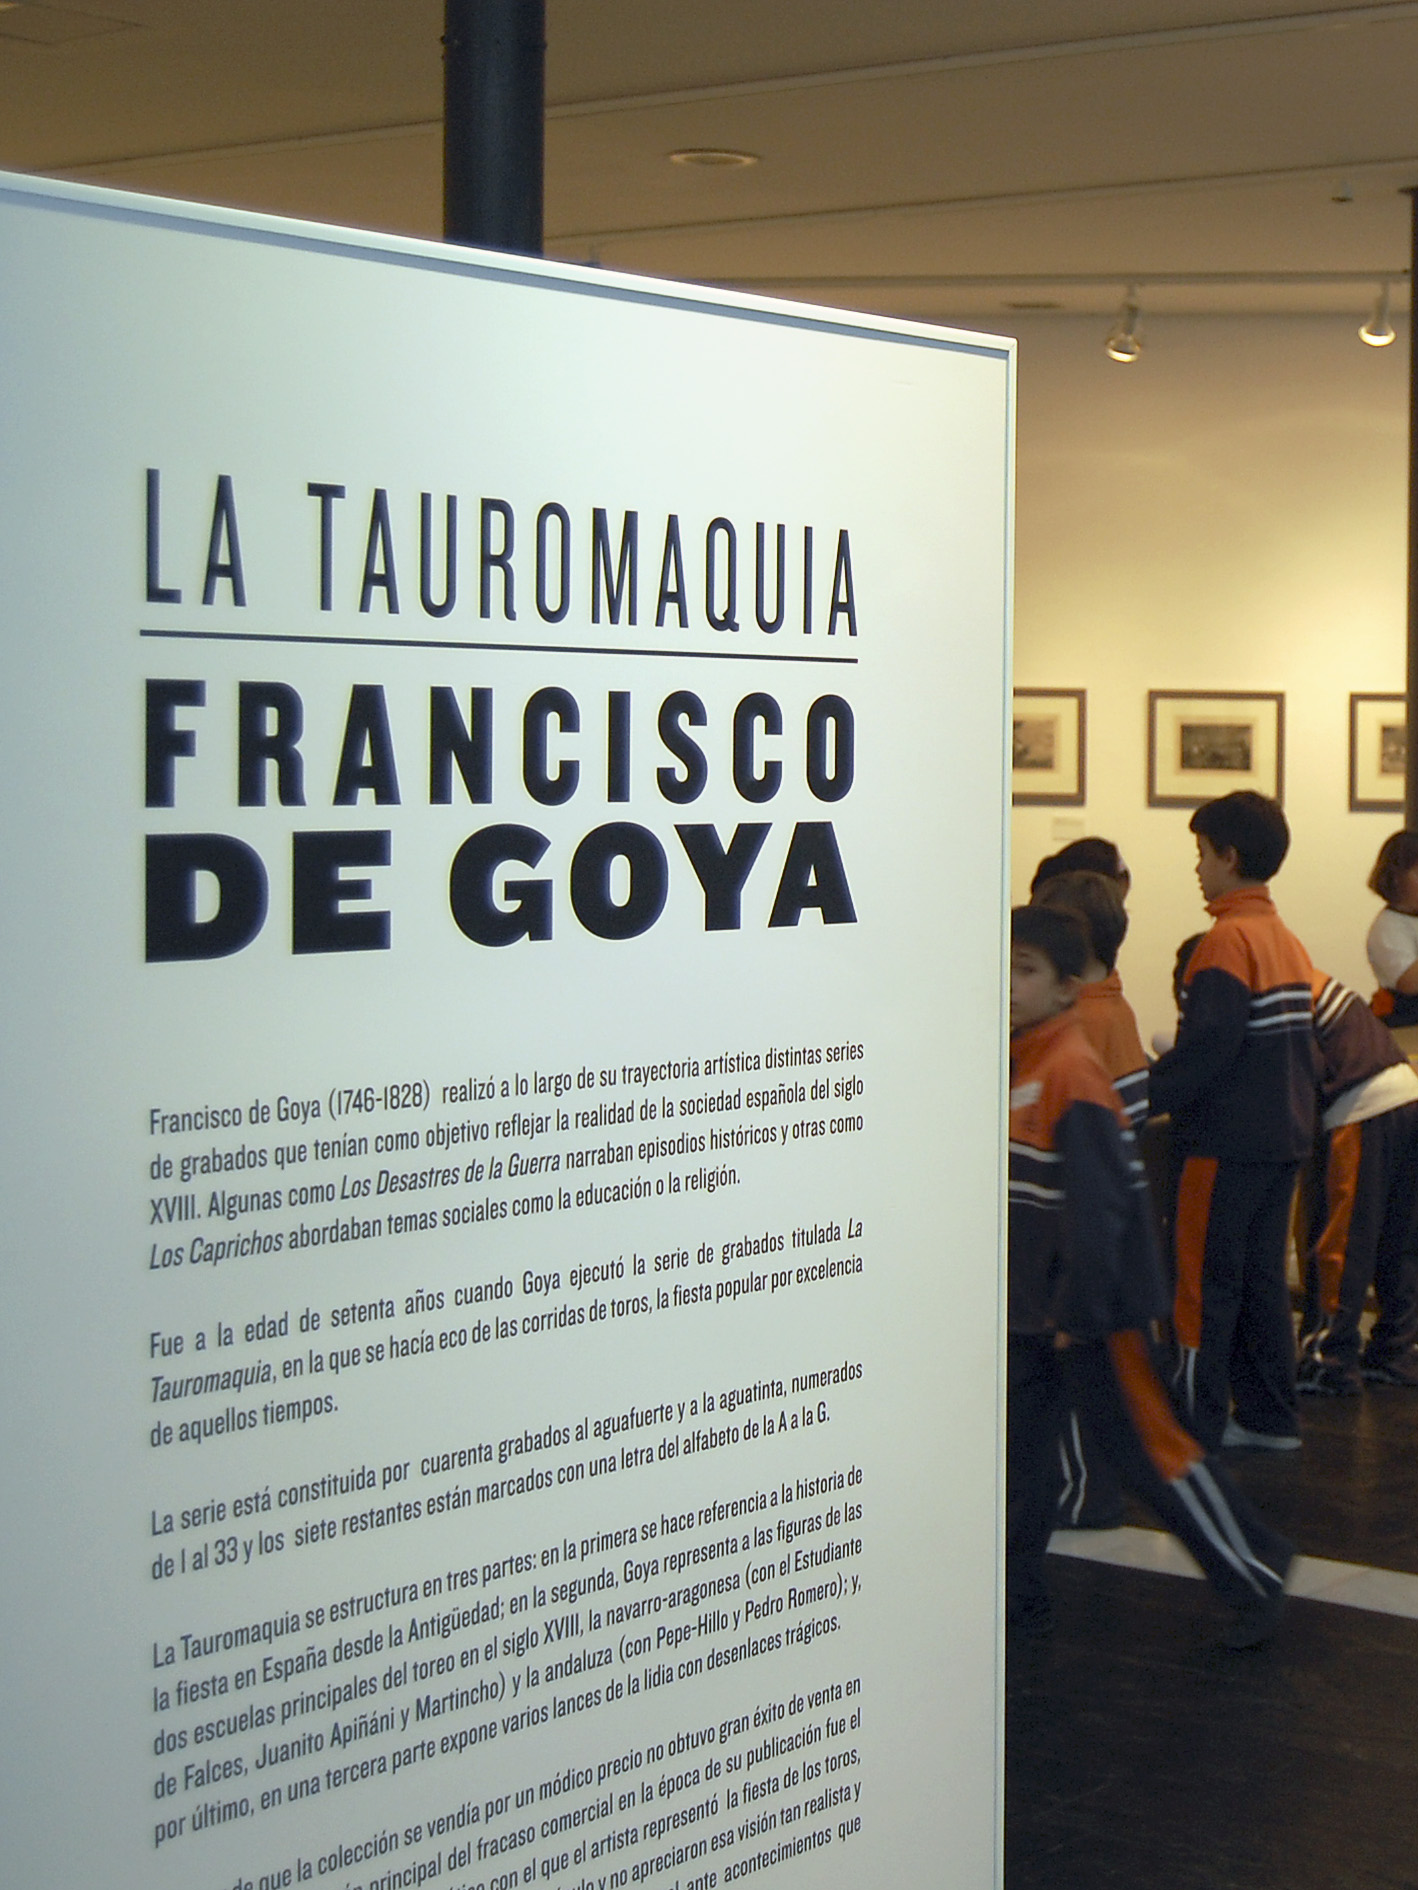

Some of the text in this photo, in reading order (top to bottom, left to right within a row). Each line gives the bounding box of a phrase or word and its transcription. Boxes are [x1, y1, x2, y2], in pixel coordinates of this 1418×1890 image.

[146, 468, 859, 636] LA TAUROMAQUIA
[145, 678, 856, 808] FRANCISCO
[145, 821, 859, 963] DE GOYA
[149, 1104, 243, 1136] Francisco
[248, 1098, 271, 1125] de
[276, 1095, 322, 1125] Goya
[441, 1074, 496, 1105] realizó
[499, 1079, 511, 1099] a
[514, 1072, 529, 1097] lo
[533, 1070, 572, 1098] largo
[576, 1065, 595, 1090] de
[598, 1068, 617, 1088] su
[620, 1055, 700, 1089] trayectoria
[703, 1050, 762, 1077] artística
[764, 1045, 823, 1070] distintas
[825, 1039, 864, 1064] series
[149, 1114, 864, 1225] XVIII. Algunas como Los Desastres de la Guerra narraban episodios históricos y otras como
[149, 1162, 741, 1270] Los Caprichos abordaban temas sociales como la educación o la religión.
[149, 1216, 863, 1359] Fue a la edad de setenta años cuando Goya ejecutó la serie de grabados titulada La
[149, 1394, 339, 1448] de aquellos tiempos.
[151, 1359, 863, 1536] La serie está constituida por cuarenta grabados al aguafuerte y a la aguatinta, numerados
[152, 1463, 863, 1669] La Tauromaquia se estructura en tres partes: en la primera se hace referencia a la historia de
[153, 1536, 863, 1756] dos escuelas principales del toreo en el siglo XVIII, la navarro-aragonesa (con el Estudiante
[154, 1772, 177, 1800] de
[183, 1756, 248, 1791] Falces,
[254, 1732, 324, 1770] Juanito
[400, 1706, 410, 1732] y
[414, 1670, 506, 1722] Martincho)
[511, 1673, 522, 1699] y
[525, 1664, 541, 1689] la
[543, 1646, 614, 1684] andaluza
[618, 1633, 652, 1665] (con
[655, 1607, 729, 1651] Pepe-Hillo
[731, 1608, 742, 1633] y
[744, 1593, 784, 1624] Pedro
[850, 1573, 862, 1596] y,
[154, 1615, 841, 1849] por último, en una tercera parte expone varios lances de la lidia con desenlaces trágicos.
[447, 1840, 471, 1872] del
[476, 1825, 536, 1862] fracaso
[540, 1791, 614, 1839] comercial
[617, 1789, 636, 1812] en
[640, 1780, 654, 1805] la
[657, 1767, 701, 1801] época
[704, 1756, 722, 1782] de
[724, 1752, 743, 1775] su
[745, 1722, 822, 1773] publicación
[824, 1715, 846, 1740] fue
[849, 1705, 861, 1731] el
[724, 1816, 862, 1883] acontecimientos que
